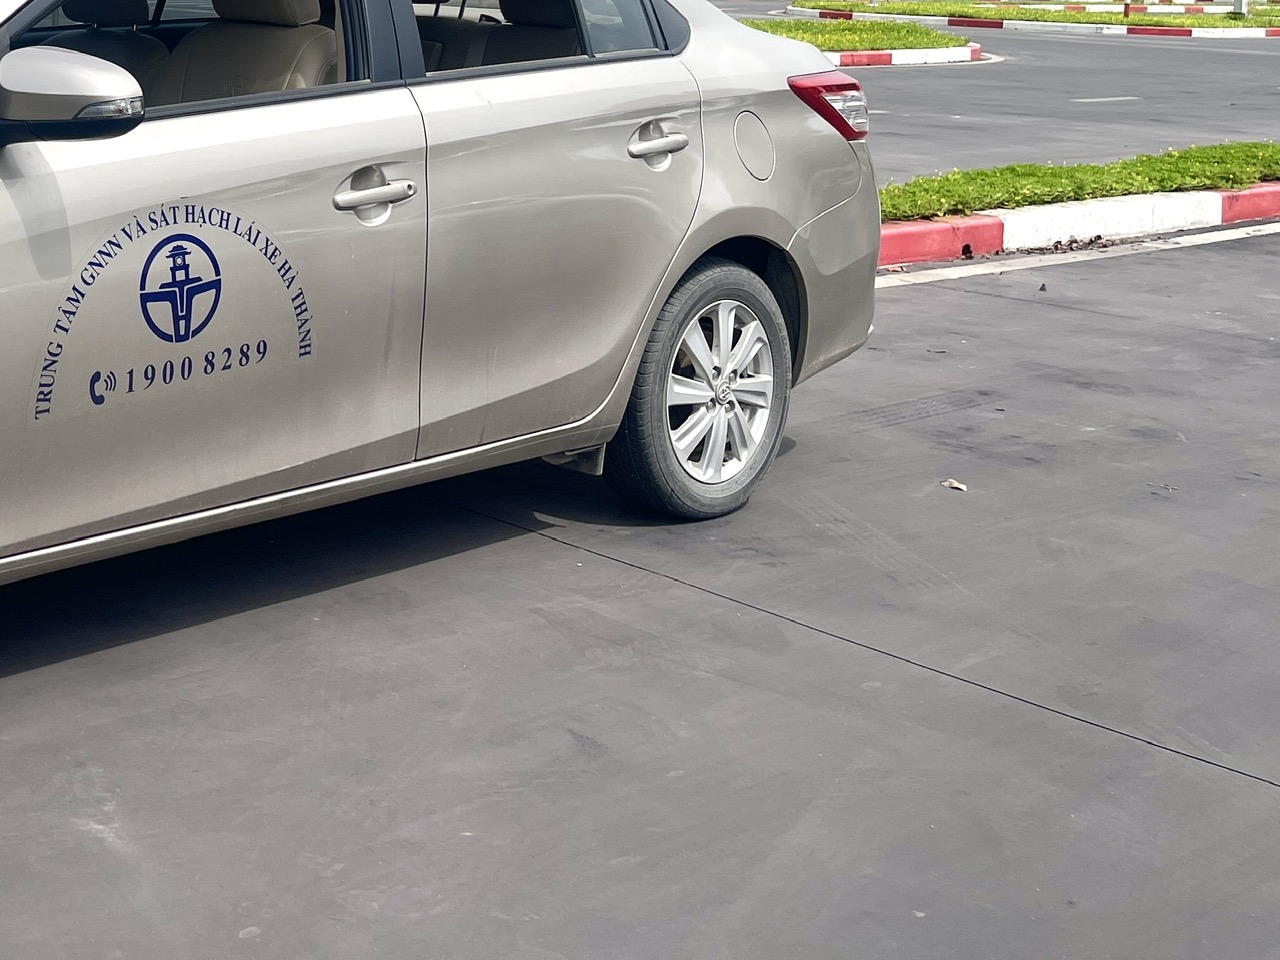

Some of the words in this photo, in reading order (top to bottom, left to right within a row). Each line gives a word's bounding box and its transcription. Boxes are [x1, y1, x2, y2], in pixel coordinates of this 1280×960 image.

[34, 341, 64, 421] TRUNG
[53, 284, 86, 335] TÂM
[80, 234, 124, 287] GNNN
[121, 215, 147, 243] VÀ
[148, 203, 180, 232] SÁT
[184, 204, 232, 229] HẠCH
[232, 217, 262, 247] LÁI
[259, 235, 283, 265] XE
[276, 258, 300, 291] HÀ
[290, 287, 312, 359] THÀNH
[125, 356, 193, 394] 1900
[203, 339, 268, 376] 8289
